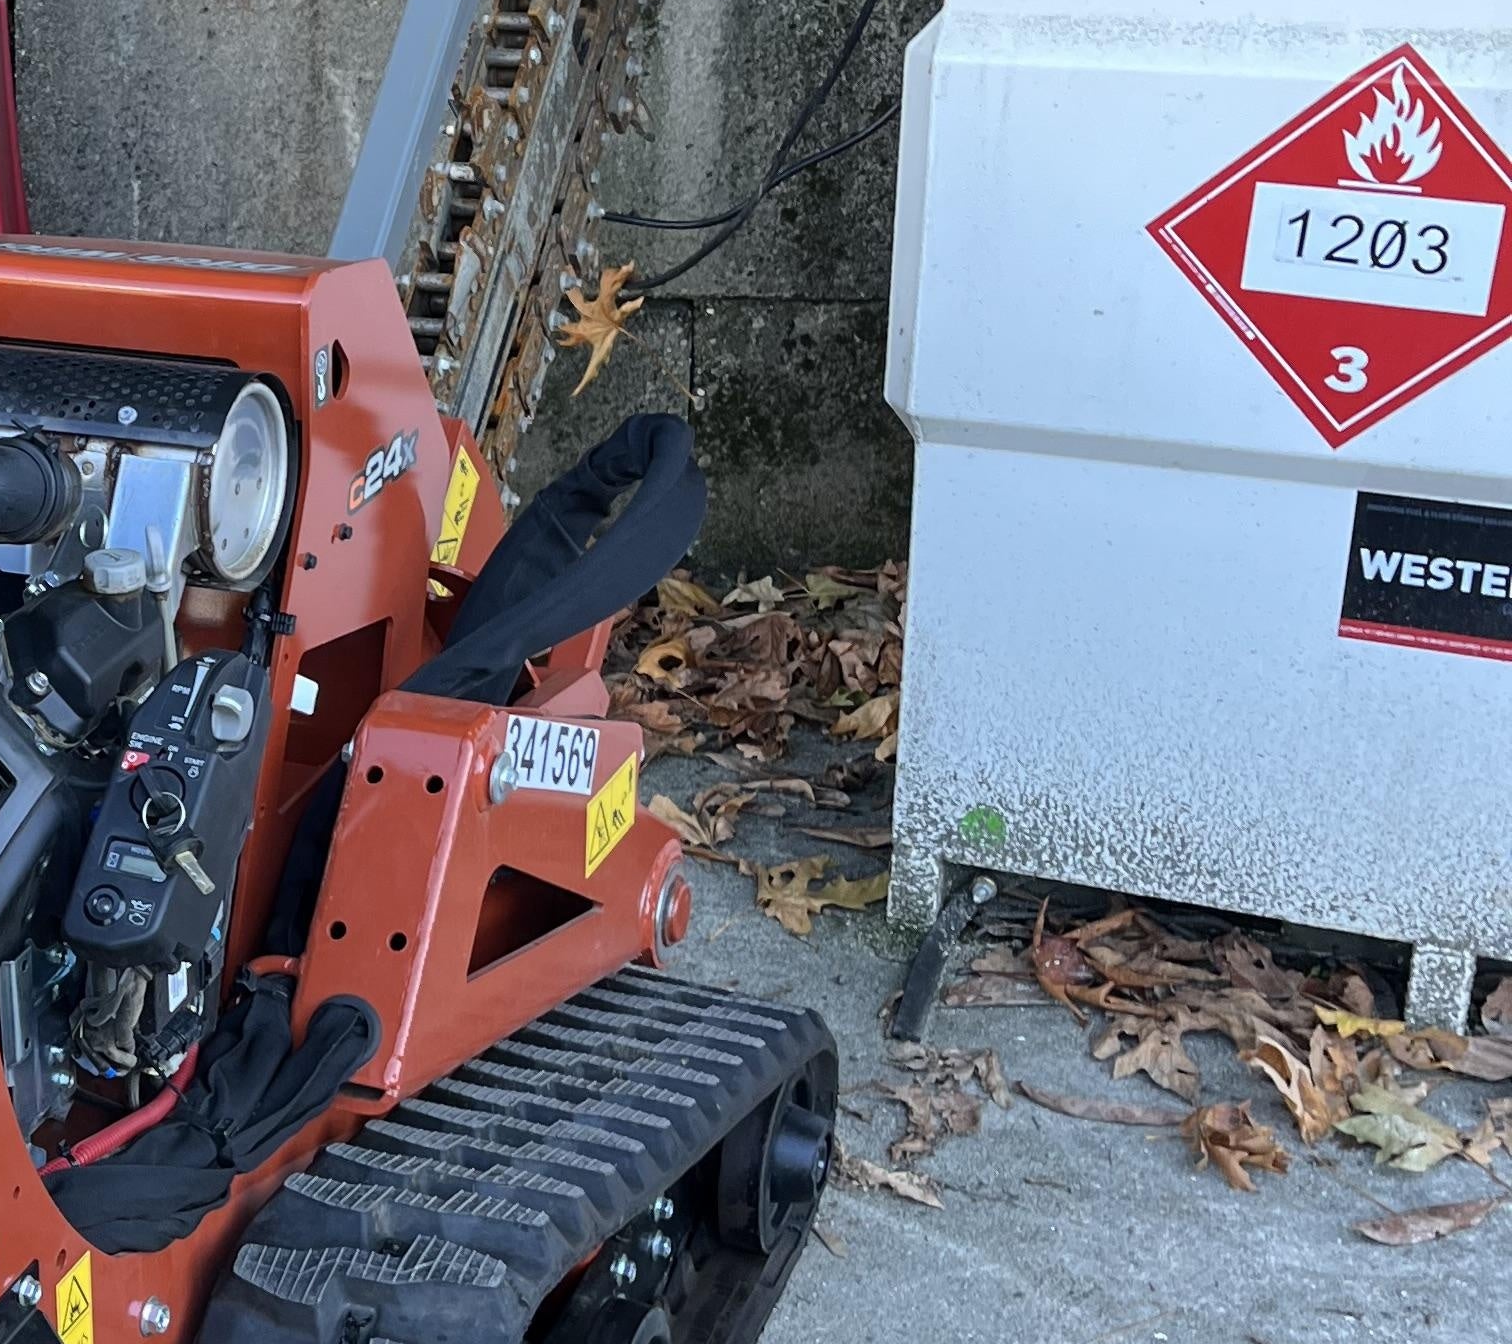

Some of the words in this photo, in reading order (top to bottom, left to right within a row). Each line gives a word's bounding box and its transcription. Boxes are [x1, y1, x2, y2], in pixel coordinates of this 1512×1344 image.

[1288, 209, 1450, 275] 1203
[1324, 346, 1369, 393] 3
[1359, 547, 1512, 599] WESTE
[507, 718, 599, 786] 341569
